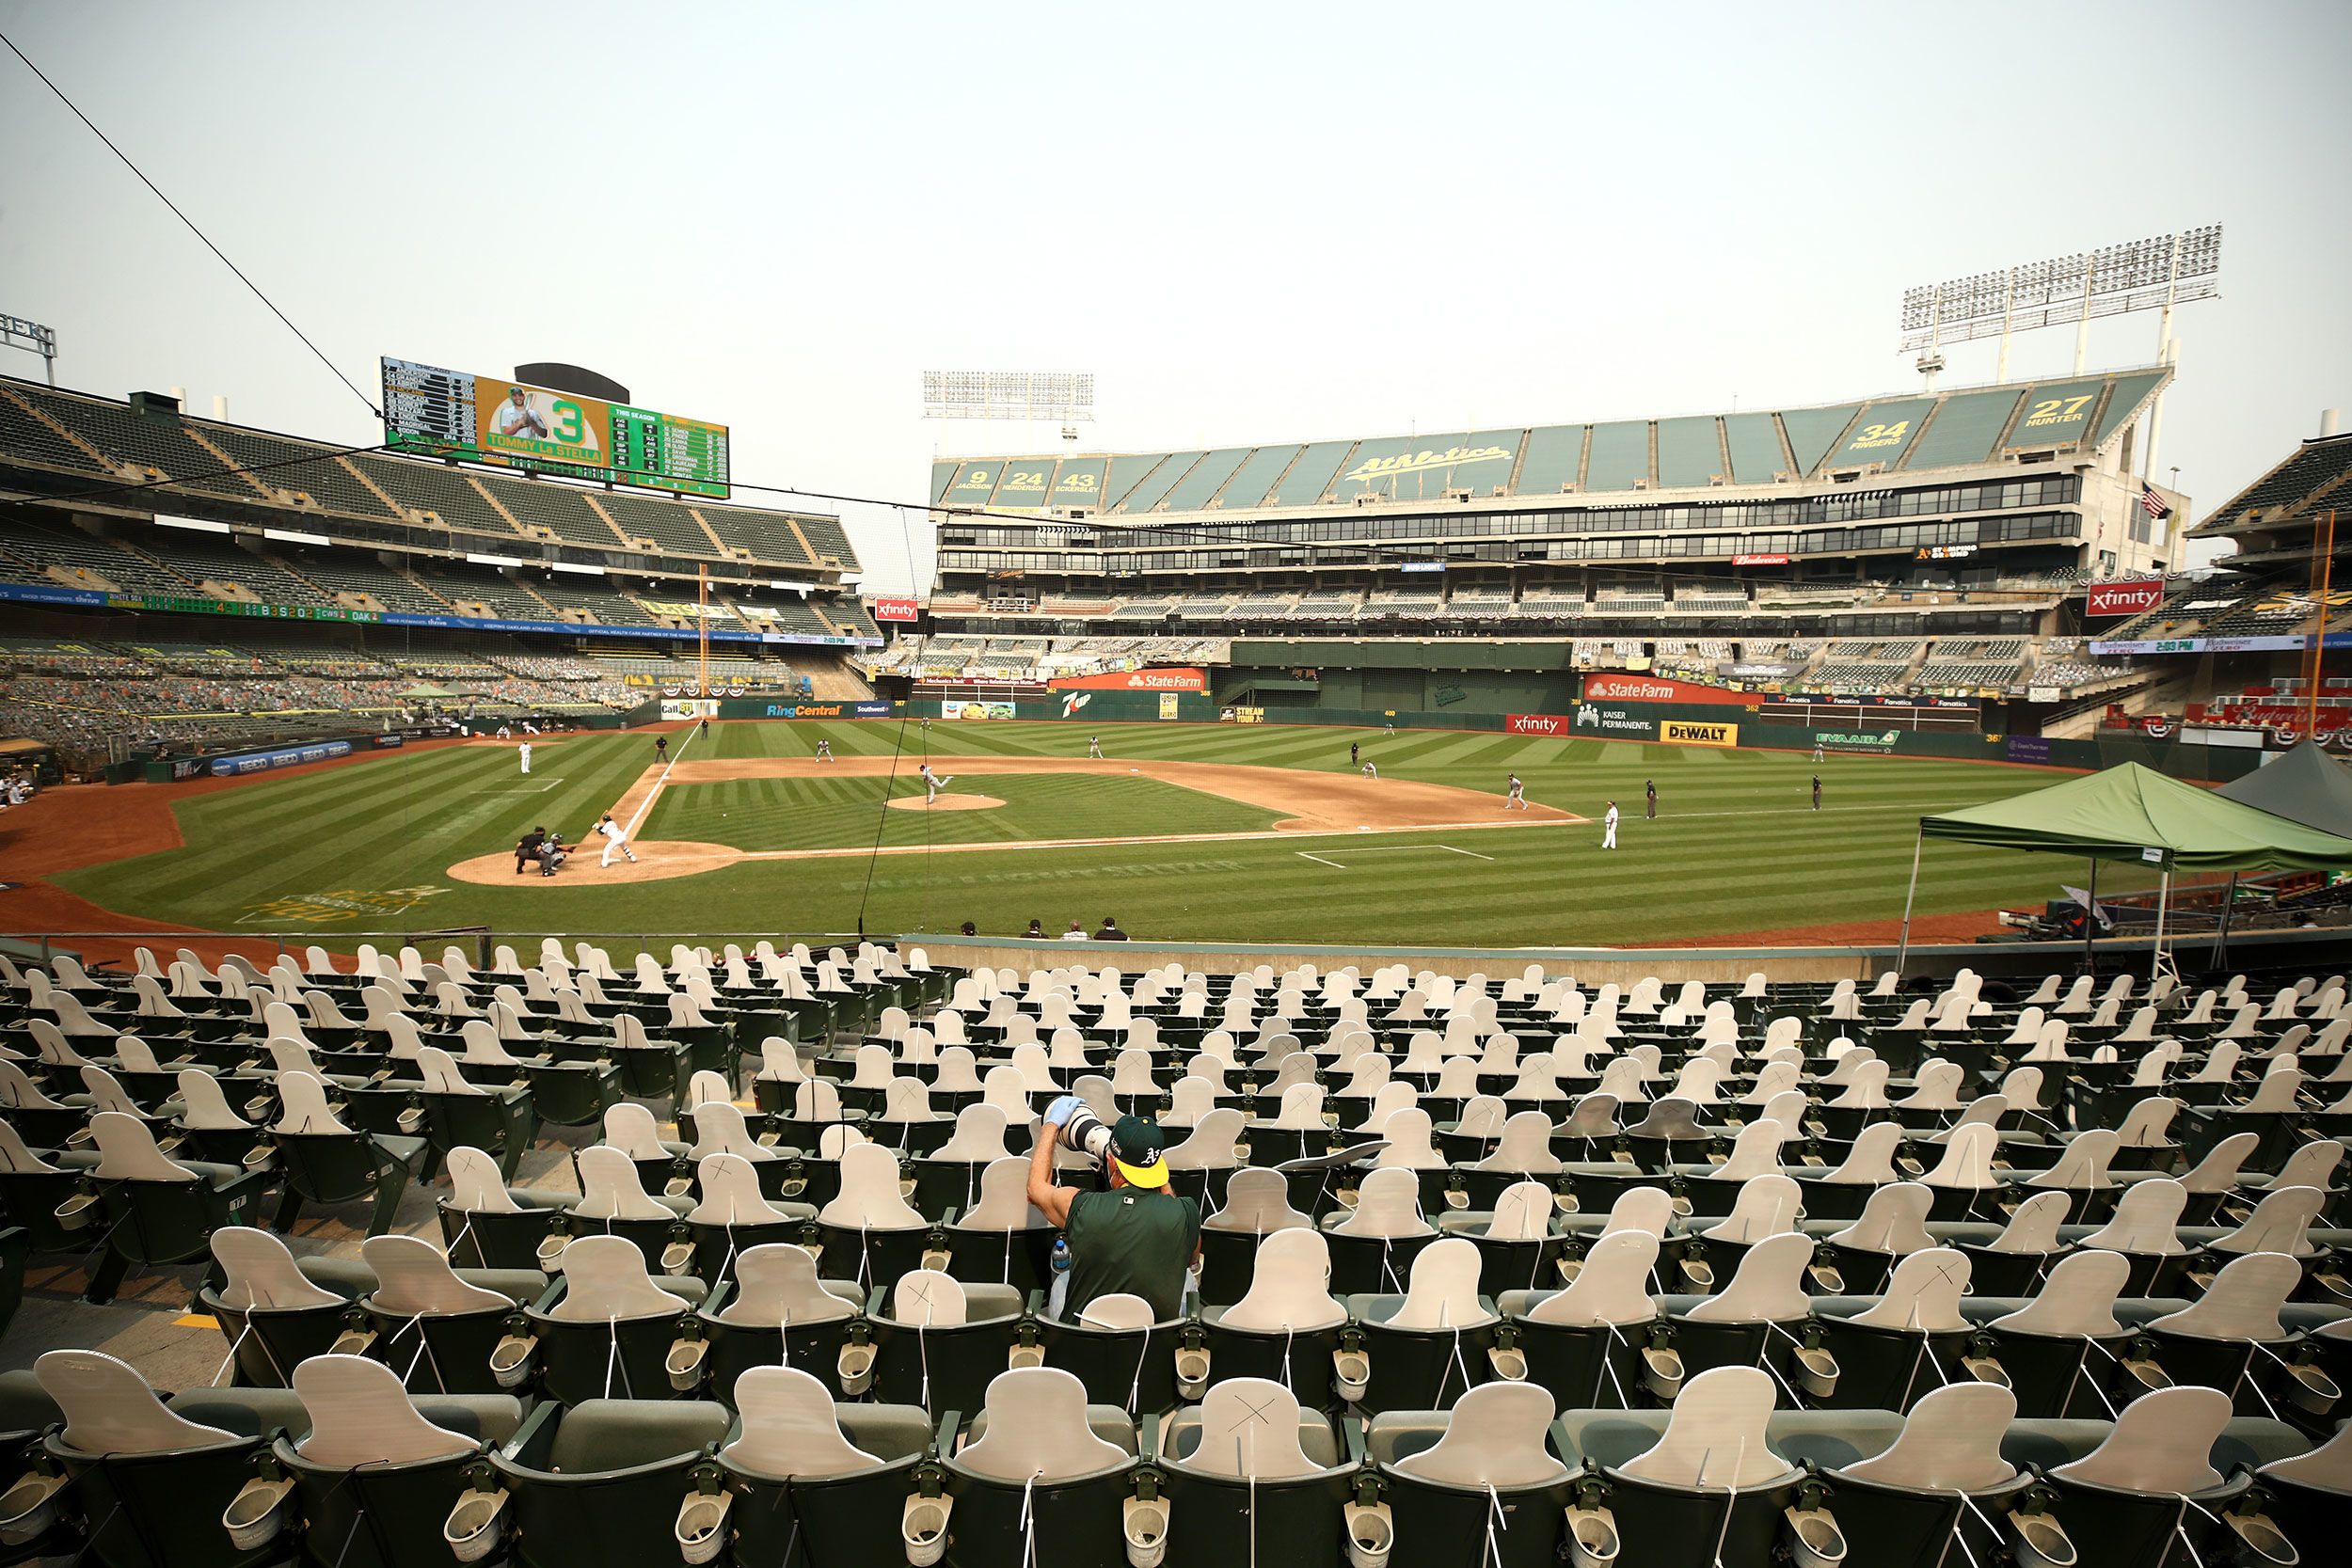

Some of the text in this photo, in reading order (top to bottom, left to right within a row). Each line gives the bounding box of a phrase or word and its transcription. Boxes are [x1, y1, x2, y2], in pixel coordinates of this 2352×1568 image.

[396, 367, 431, 379] ANDERSON
[415, 363, 451, 374] CHICAGO
[396, 373, 427, 385] GRANDAL
[396, 392, 429, 404] MONCADA
[397, 405, 426, 416] MAZARA
[2027, 395, 2093, 420] 27
[616, 408, 656, 422] THIS SEASON
[2026, 412, 2083, 428] HUNTER
[398, 420, 431, 431] MADRIGAL
[552, 400, 586, 444] 3
[1856, 421, 1909, 442] 34
[489, 434, 600, 462] TOMMY La STELLA
[1849, 437, 1901, 451] FINGERS
[1345, 446, 1512, 481] Athletics
[969, 471, 989, 483] 9
[1010, 473, 1043, 485] 24
[1062, 473, 1095, 487] 43
[1735, 555, 1787, 564] Budweiser
[75, 594, 100, 604] thrive
[2092, 589, 2159, 610] xfinity
[216, 602, 225, 612] 4
[262, 605, 270, 616] B
[271, 606, 278, 616] 3
[279, 607, 287, 617] S
[288, 607, 296, 618] 2
[306, 609, 313, 619] 2
[879, 603, 915, 617] xfinity
[322, 609, 339, 618] CWS
[352, 611, 371, 621] OAK
[427, 617, 447, 626] thrive
[2099, 641, 2147, 649] Budweiser
[2155, 641, 2177, 653] 2:03
[2178, 641, 2194, 651] PM
[2206, 638, 2253, 647] Budweiser
[1786, 695, 1811, 704] Fanatics
[1834, 697, 1860, 705] Fanatics
[1884, 698, 1912, 706] Fanatics
[1939, 699, 1968, 707] Fanatics
[661, 703, 692, 714] Call 811
[767, 705, 841, 718] RingCentral
[1236, 707, 1264, 716] STREAM
[1603, 711, 1626, 720] KAISER
[1515, 716, 1559, 734] xfinity
[1602, 721, 1650, 730] PERMANENTE
[1986, 735, 2002, 743] 367
[238, 757, 267, 771] GEICO
[272, 753, 298, 766] GEICO
[303, 749, 326, 760] GEICO
[329, 745, 349, 755] GEICO
[1140, 1147, 1161, 1164] A's
[234, 1197, 242, 1209] 17
